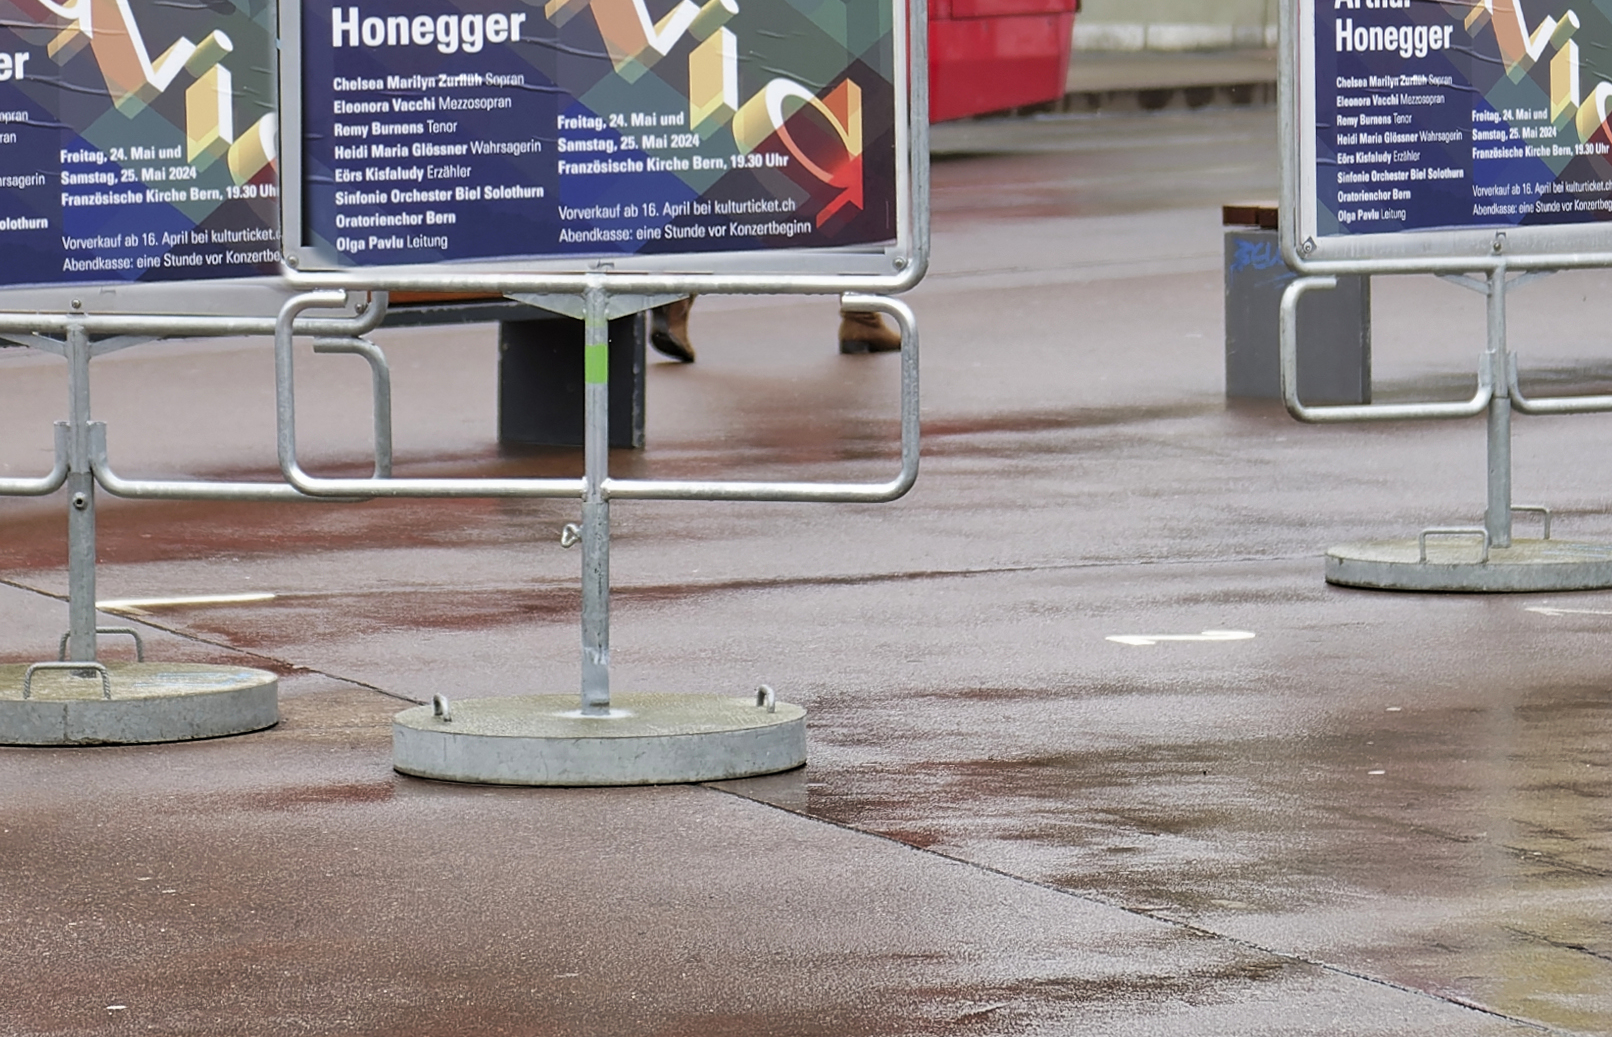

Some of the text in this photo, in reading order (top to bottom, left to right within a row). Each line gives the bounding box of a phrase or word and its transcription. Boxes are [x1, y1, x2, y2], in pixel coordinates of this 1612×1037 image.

[331, 6, 526, 54] Honegger
[1335, 18, 1454, 59] Honegger
[557, 152, 789, 175] Französische Kirche Bern, 19.30 Uhr
[334, 184, 544, 205] Sinfonie Orchester Biel Solothurn
[1337, 188, 1411, 203] Oratorienchor Bern
